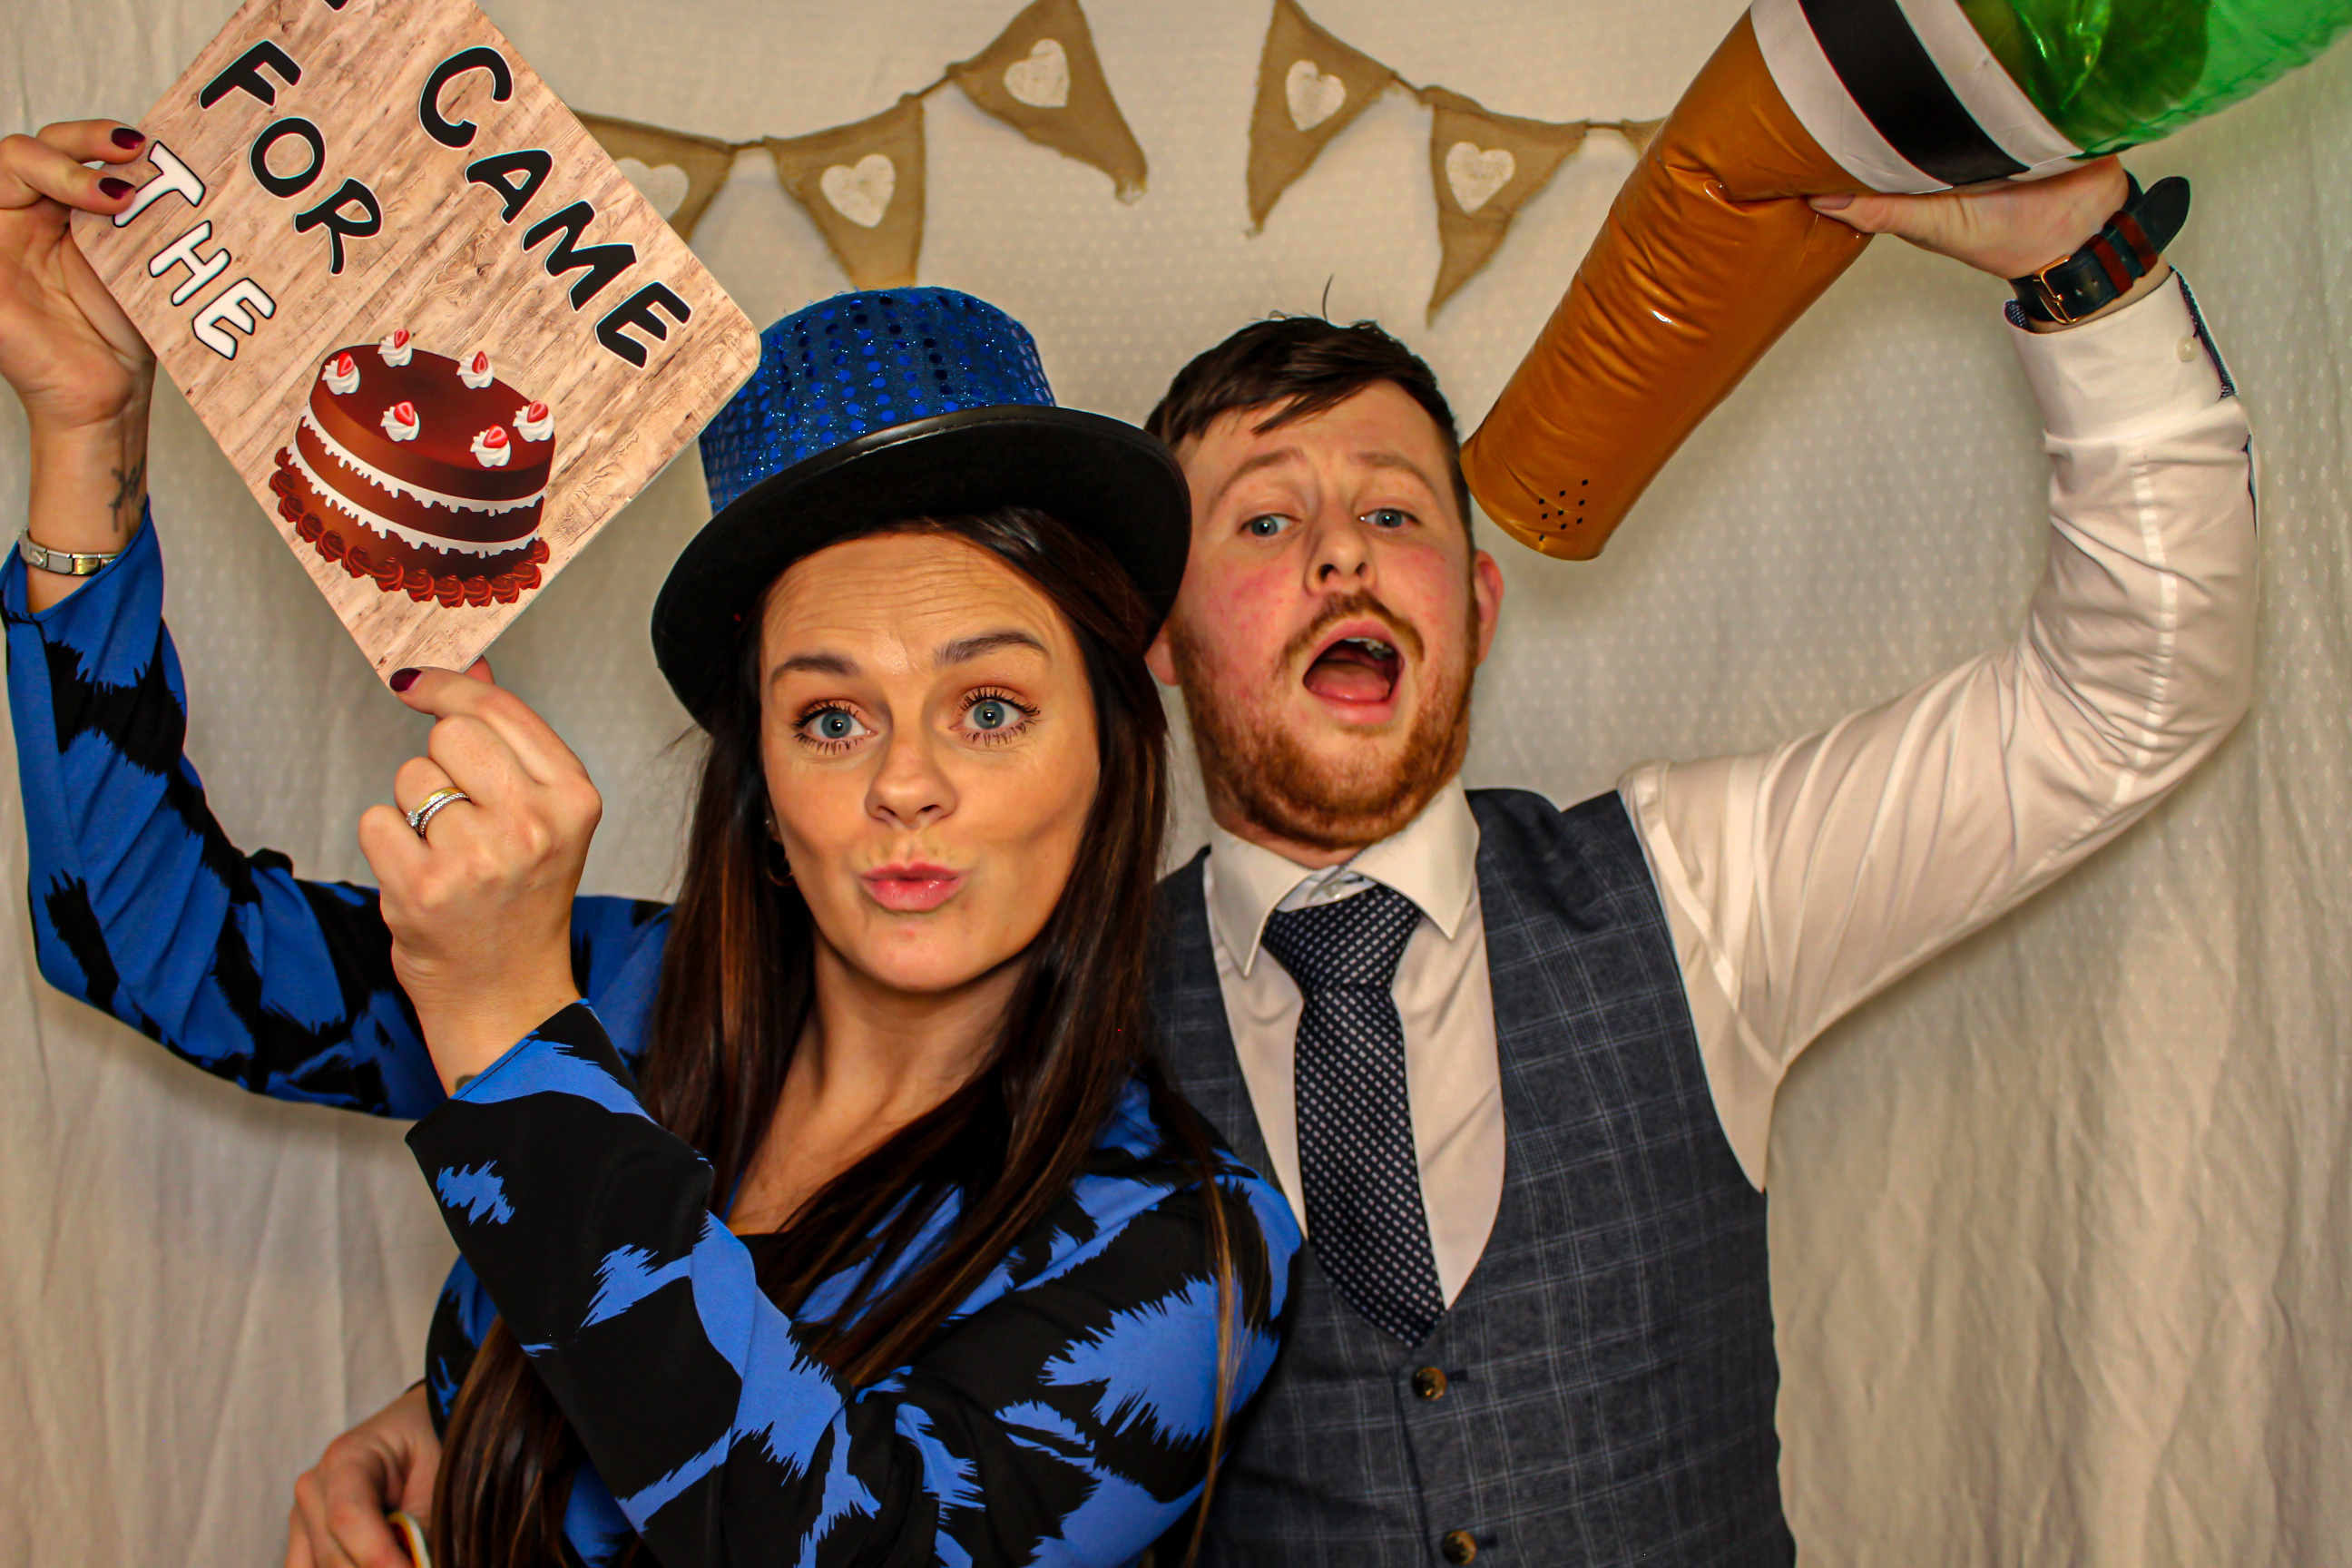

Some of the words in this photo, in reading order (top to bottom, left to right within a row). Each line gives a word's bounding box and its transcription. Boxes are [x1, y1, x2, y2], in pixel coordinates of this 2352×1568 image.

[113, 140, 277, 360] THE
[199, 40, 383, 276] FOR
[419, 46, 692, 368] CAME
